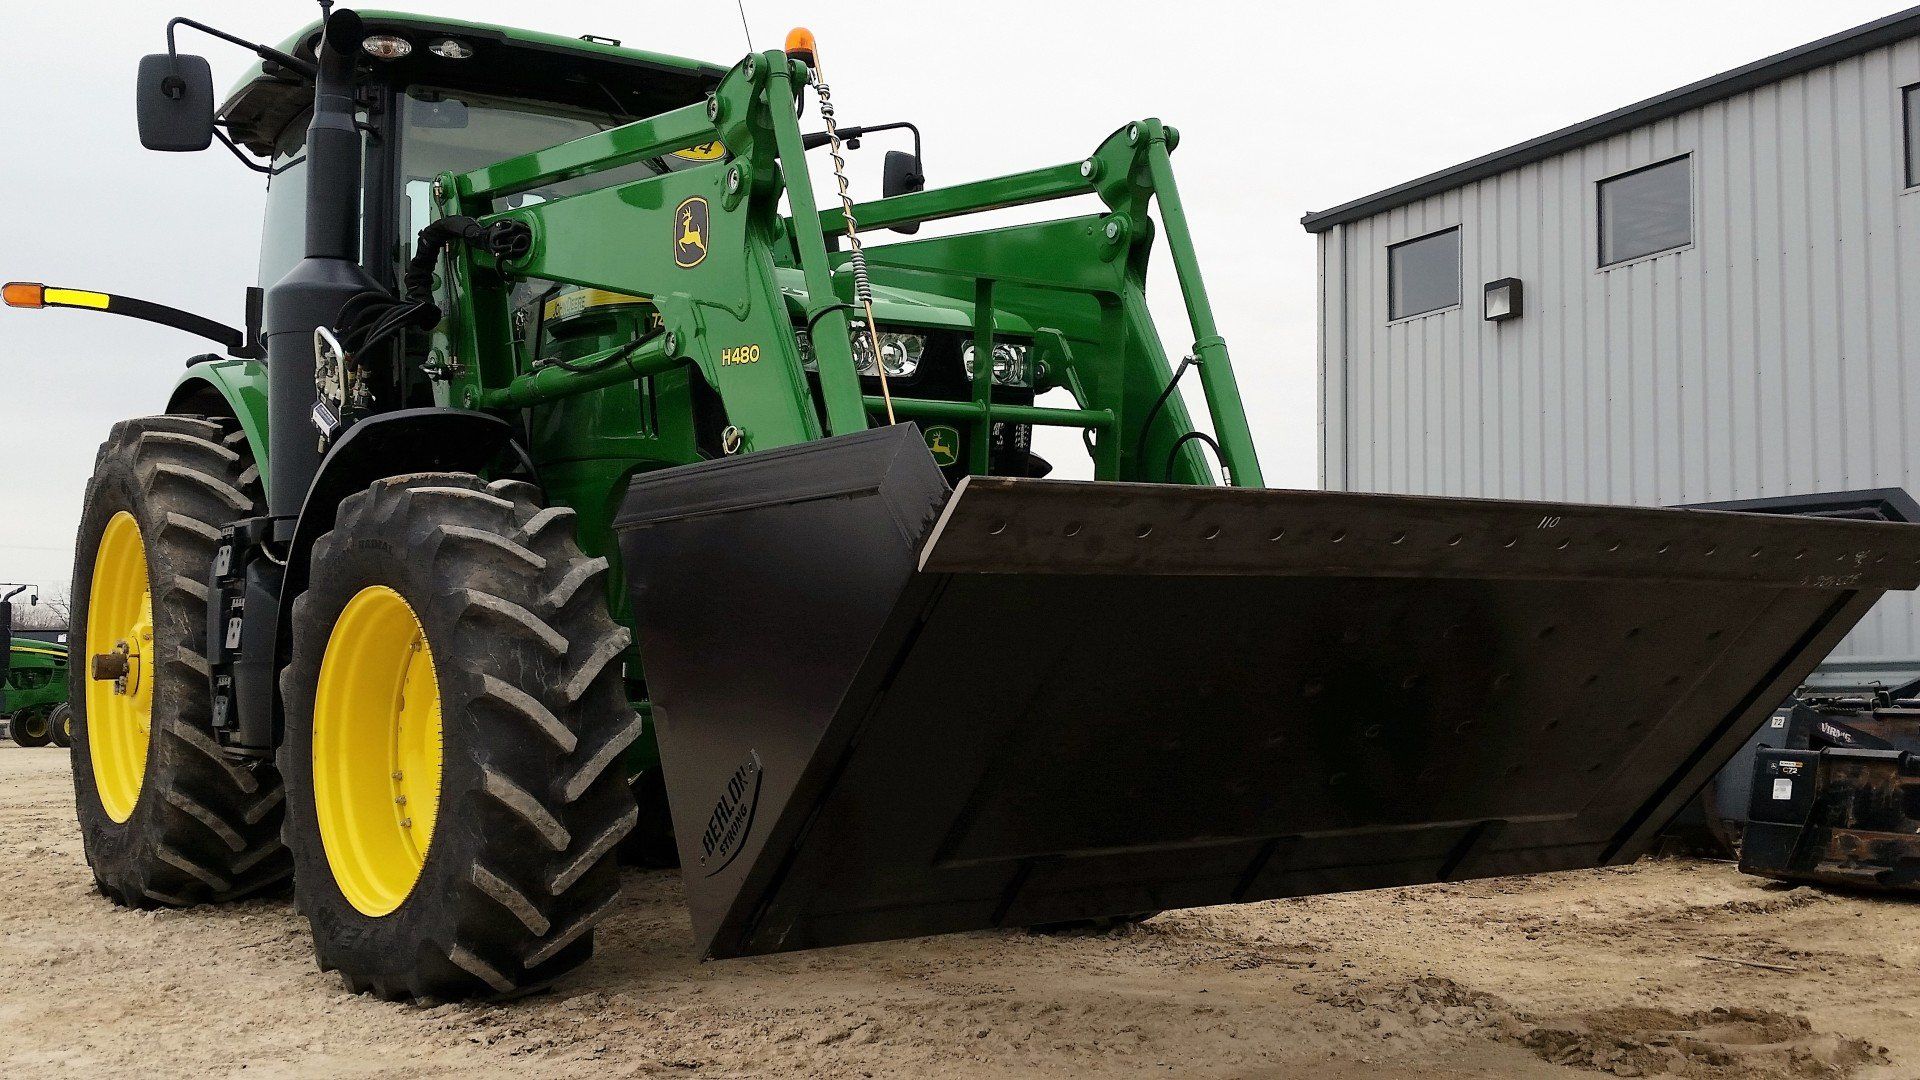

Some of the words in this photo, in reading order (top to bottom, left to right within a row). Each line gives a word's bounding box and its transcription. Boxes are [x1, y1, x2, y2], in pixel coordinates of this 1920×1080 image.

[721, 343, 761, 367] H480
[1536, 515, 1561, 529] 110
[702, 765, 749, 857] BERLON
[719, 803, 748, 857] STRONG
